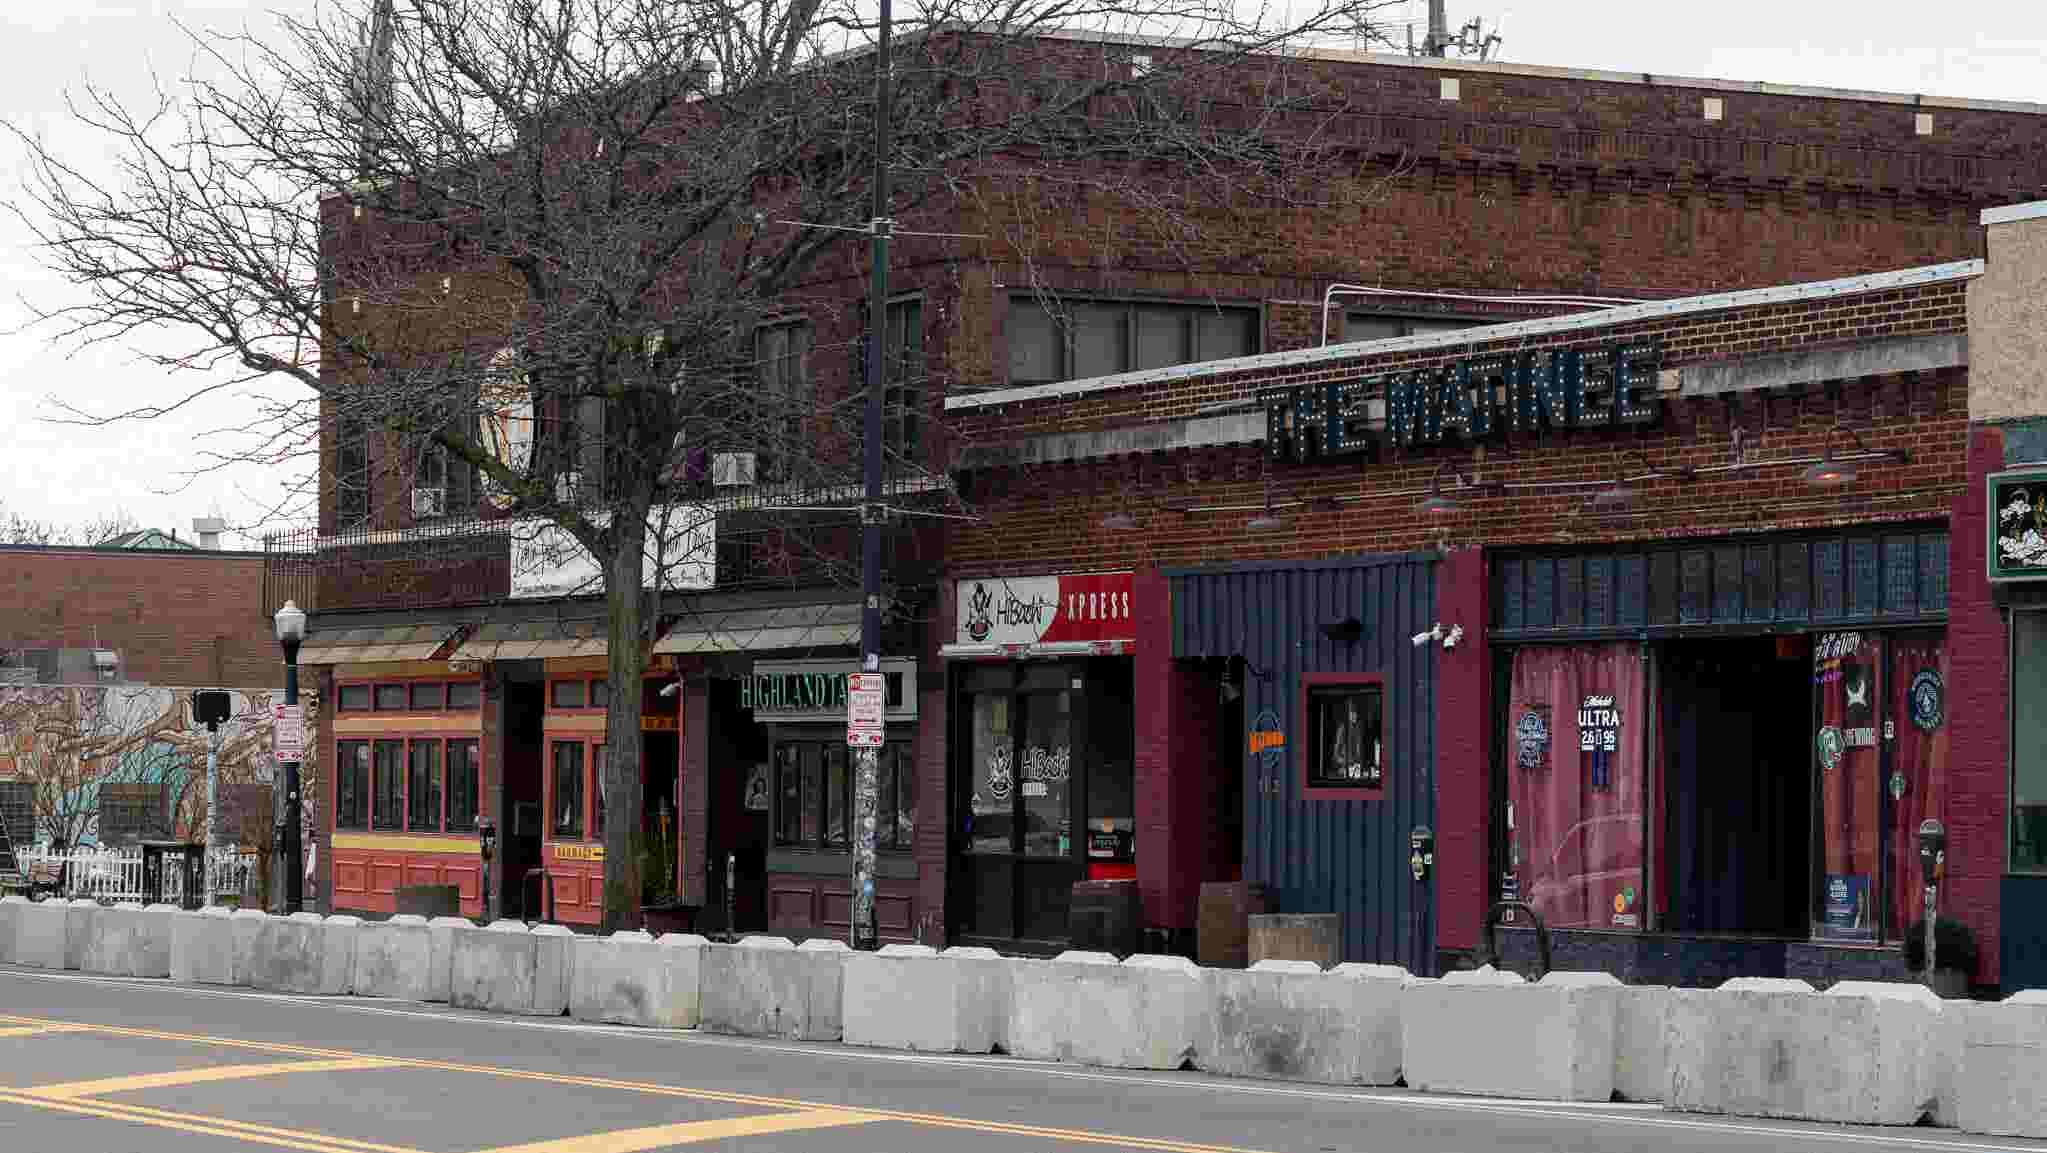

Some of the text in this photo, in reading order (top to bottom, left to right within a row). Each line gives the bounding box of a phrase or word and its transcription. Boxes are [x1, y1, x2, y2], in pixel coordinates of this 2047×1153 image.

[1259, 346, 1660, 459] THE MATINEE
[1067, 591, 1130, 621] XPRESS
[739, 673, 828, 708] HIGHLAND
[1578, 709, 1620, 727] ULTRA
[1603, 730, 1616, 744] 95
